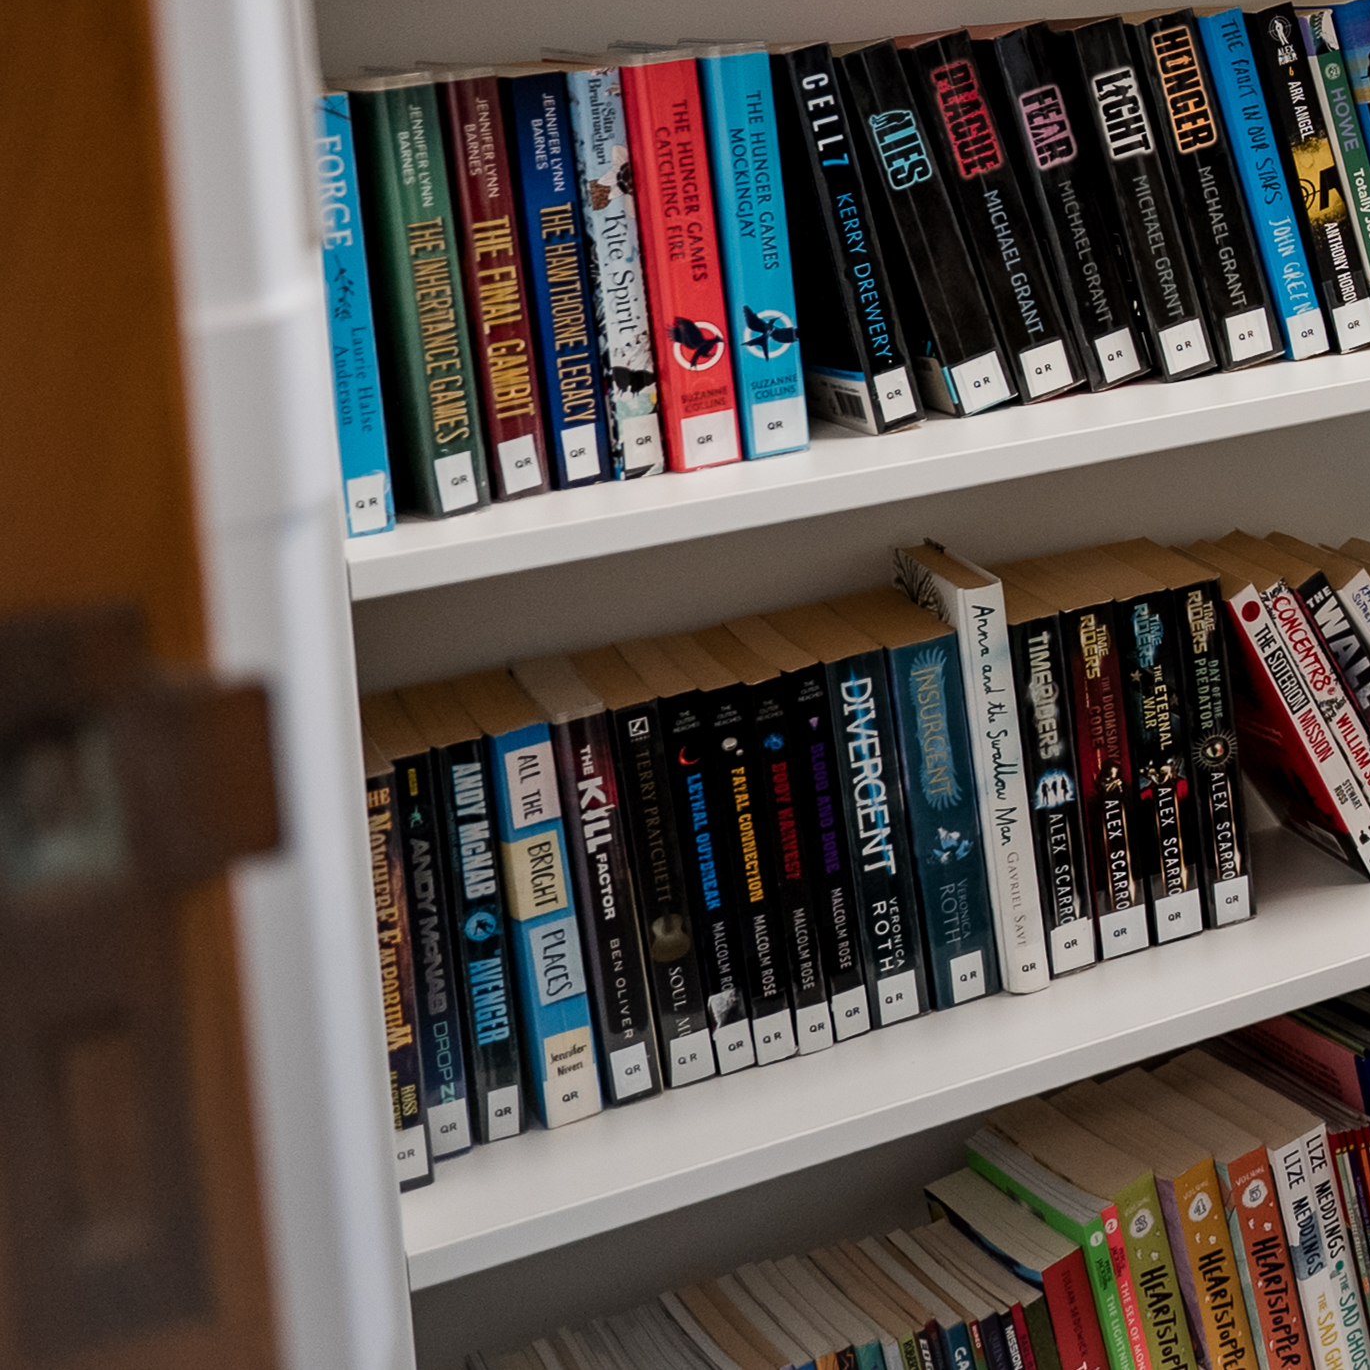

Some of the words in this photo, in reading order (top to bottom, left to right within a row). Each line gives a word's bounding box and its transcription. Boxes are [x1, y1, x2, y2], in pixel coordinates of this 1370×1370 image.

[1221, 19, 1244, 53] THE
[746, 90, 764, 124] THE
[1151, 26, 1218, 155] HUNGER
[1231, 59, 1258, 98] FAULT
[1288, 81, 1305, 104] ARK
[542, 93, 561, 155] JENNIFER
[672, 99, 691, 134] THE
[802, 72, 837, 153] CELL
[822, 153, 851, 168] 7
[1020, 85, 1077, 171] FEAR
[1242, 104, 1262, 121] IN
[1250, 126, 1270, 152] OUR
[1295, 105, 1315, 139] ANGEL
[1331, 87, 1359, 152] HOWE
[531, 119, 548, 170] BARNES
[656, 126, 680, 218] CATCHING
[751, 132, 772, 204] HUNGER
[314, 134, 353, 250] FORGE
[551, 157, 565, 192] LYNN
[677, 141, 700, 216] HUNGER
[730, 128, 756, 239] MOCKINGJAY
[1256, 157, 1283, 205] STARS
[472, 214, 514, 262] THE
[540, 202, 574, 239] THE
[602, 210, 627, 261] Kite
[667, 224, 685, 261] FIRE
[759, 211, 779, 271] GAMES
[1269, 215, 1296, 257] JOHN
[1325, 222, 1349, 271] ANTHONY
[687, 222, 708, 281] GAMES
[983, 189, 1021, 271] MICHAEL
[1010, 273, 1044, 335] GRANT
[477, 265, 522, 335] FINAL
[544, 242, 588, 351] HAWTHORNE
[607, 269, 640, 334] Spirit
[1282, 262, 1314, 315] GREEN
[352, 326, 367, 379] Laurie
[407, 216, 446, 255] THE
[429, 375, 470, 444] GAMES
[334, 345, 353, 426] Anderson
[487, 338, 535, 419] GAMBIT
[556, 353, 596, 422] LEGACY
[751, 374, 797, 389] SUZANNE
[755, 385, 796, 399] COLLINS
[358, 387, 373, 433] Halse
[767, 421, 783, 430] QR
[1305, 585, 1333, 610] THE
[972, 605, 995, 657] Anna
[982, 664, 1006, 695] and
[1028, 632, 1060, 760] TIMERIDERS
[1194, 658, 1214, 730] PREDATOR
[1268, 647, 1311, 715] SOTERION
[1298, 709, 1335, 764] MISSION
[910, 664, 952, 795] INSURGENT
[988, 701, 1008, 723] the
[452, 762, 486, 817] ANDY
[518, 754, 541, 784] ALL
[731, 767, 749, 812] FATAL
[840, 676, 896, 876] DIVERGENT
[986, 729, 1018, 800] Swallow
[521, 789, 543, 820] THE
[577, 776, 616, 854] KILL
[995, 807, 1017, 846] Man
[528, 841, 558, 907] BRIGHT
[596, 853, 616, 921] FACTOR
[738, 813, 765, 904] CONNECTION
[542, 928, 572, 997] PLACES
[469, 957, 509, 1047] AVENGER
[562, 1091, 578, 1103] QR
[1306, 1134, 1327, 1174] LIZE
[1314, 1180, 1346, 1260] MEDDINGS
[1251, 1235, 1300, 1368] HEARTSTOPPER
